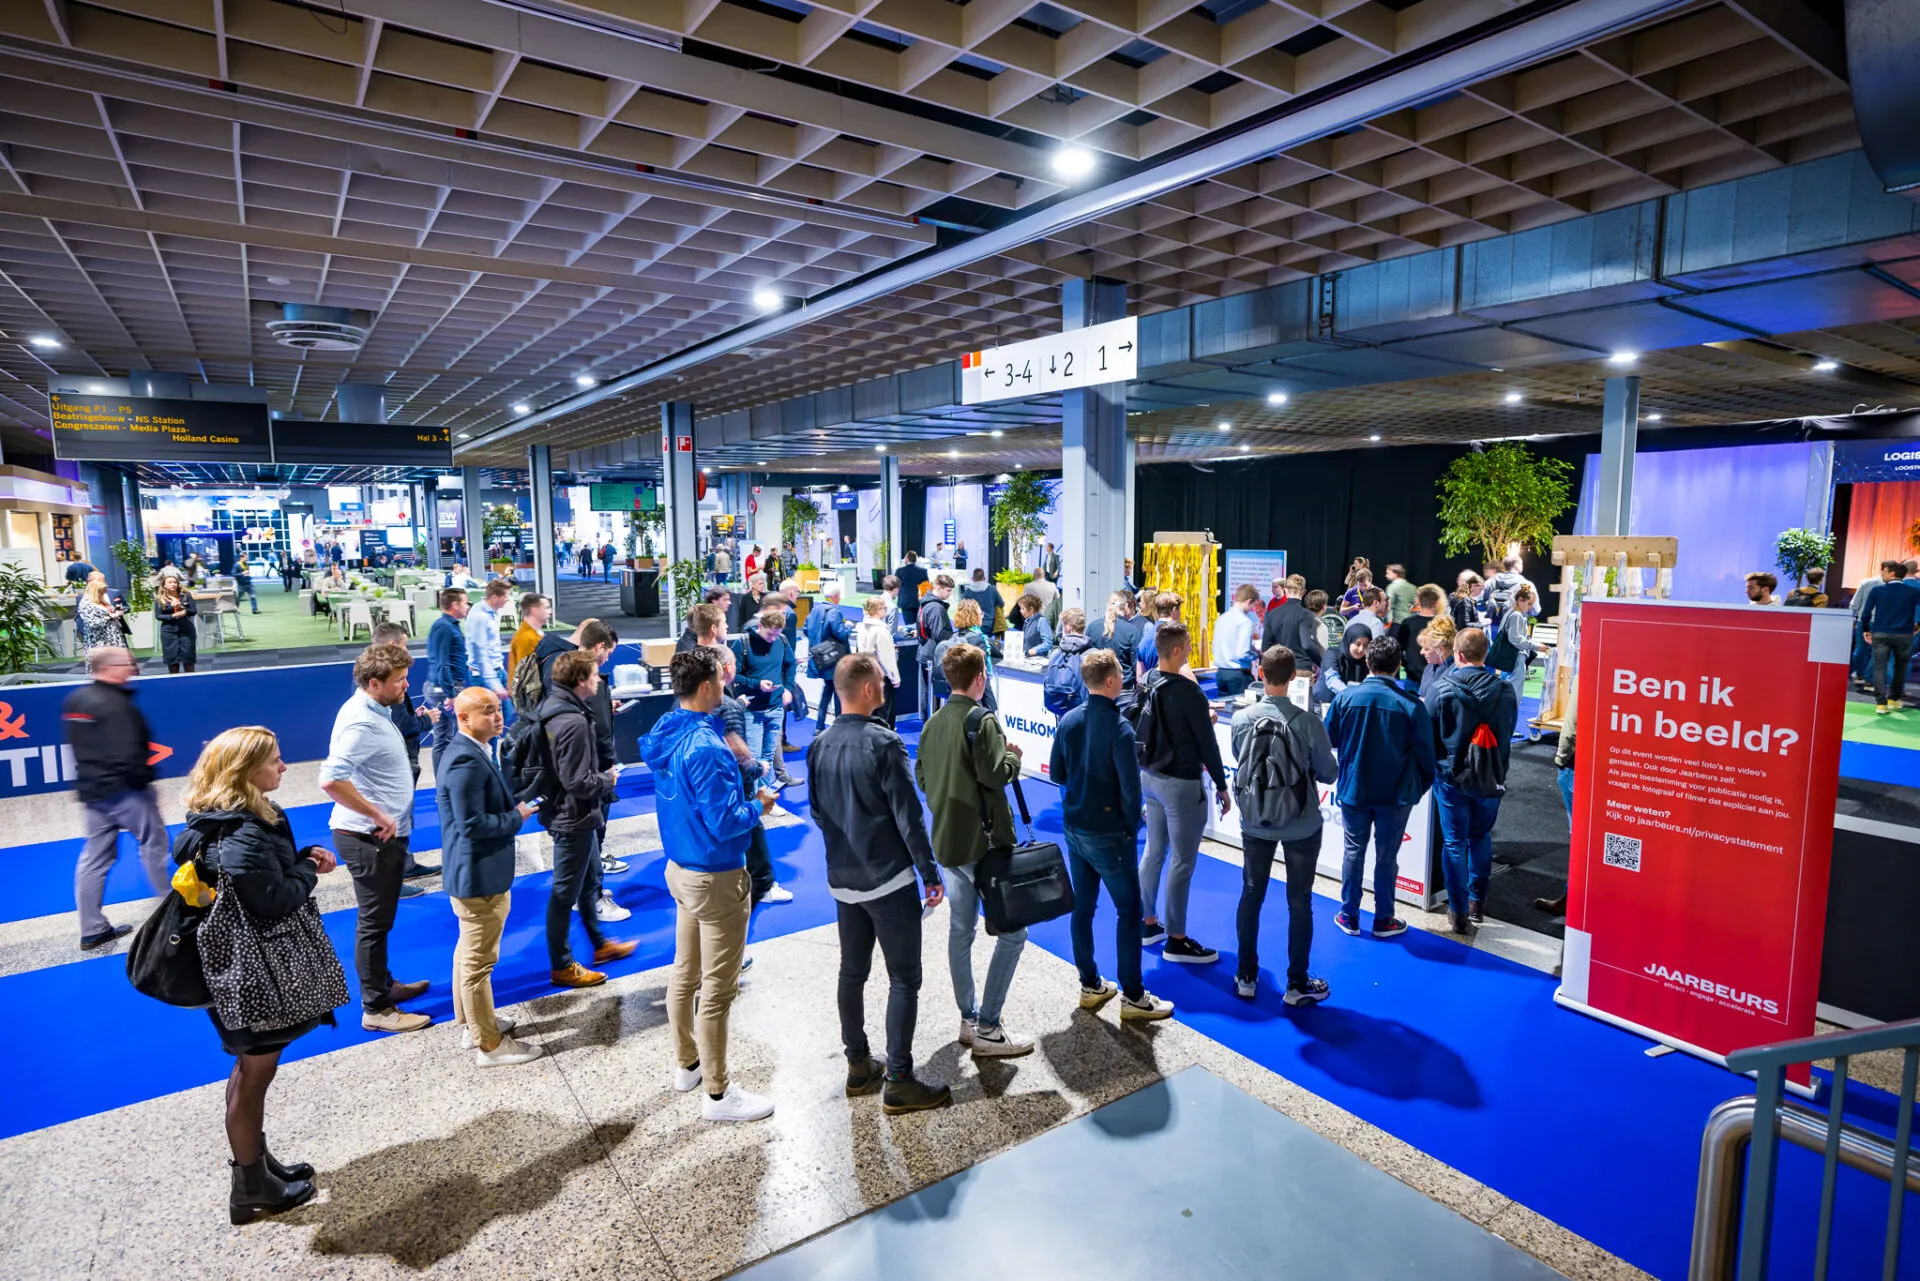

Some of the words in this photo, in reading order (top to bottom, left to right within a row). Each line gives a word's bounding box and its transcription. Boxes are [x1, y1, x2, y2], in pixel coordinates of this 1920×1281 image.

[1005, 360, 1032, 386] 3-4
[1063, 352, 1074, 377] 2
[1098, 345, 1108, 371] 1
[52, 402, 91, 413] Uitgang
[135, 415, 149, 423] NS
[152, 415, 185, 425] Station
[54, 420, 120, 431] Congreszalen
[129, 423, 159, 433] Media
[172, 433, 207, 443] Holland
[209, 435, 239, 444] Casino
[417, 434, 430, 442] Hal
[432, 434, 437, 442] 3
[1612, 668, 1687, 702] Ben
[1699, 675, 1736, 707] ik
[1004, 714, 1057, 740] WELKOM
[1610, 704, 1643, 735] in
[1654, 710, 1800, 756] beeld?
[1608, 758, 1641, 769] gemaakt.
[1643, 762, 1658, 771] Ook
[1660, 766, 1677, 775] door
[1678, 769, 1718, 782] Jaarbeurs
[1719, 776, 1736, 785] zelf.
[1609, 746, 1620, 755] Op
[1621, 748, 1632, 756] dit
[1633, 750, 1653, 759] event
[1654, 754, 1682, 764] worden
[1684, 758, 1700, 766] veel
[1701, 761, 1723, 770] foto's
[1725, 765, 1736, 773] en
[1737, 767, 1767, 778] video's
[1607, 779, 1631, 790] vraagt
[1631, 783, 1641, 791] de
[1642, 785, 1674, 797] fotograaf
[1675, 790, 1684, 799] of
[1685, 792, 1707, 803] filmer
[1708, 797, 1721, 806] dat
[1723, 800, 1757, 813] expliciet
[1758, 806, 1774, 816] aan
[1775, 811, 1792, 819] jou.
[1608, 768, 1620, 776] Als
[1620, 770, 1638, 780] jouw
[1640, 774, 1688, 789] toestemming
[1689, 782, 1706, 791] voor
[1707, 786, 1748, 798] publicatie
[1749, 793, 1773, 805] nodig
[1775, 796, 1784, 806] is,
[1606, 799, 1632, 811] Meer
[1633, 806, 1672, 819] weten?
[1605, 810, 1622, 821] Kijk
[1623, 814, 1636, 824] op
[1637, 815, 1784, 855] jaarbeurs.nl/privacystatement
[1643, 963, 1779, 1015] JAARBEURS
[1663, 981, 1686, 994] attract
[1689, 990, 1714, 1003] engage
[1718, 999, 1756, 1016] accelerate
